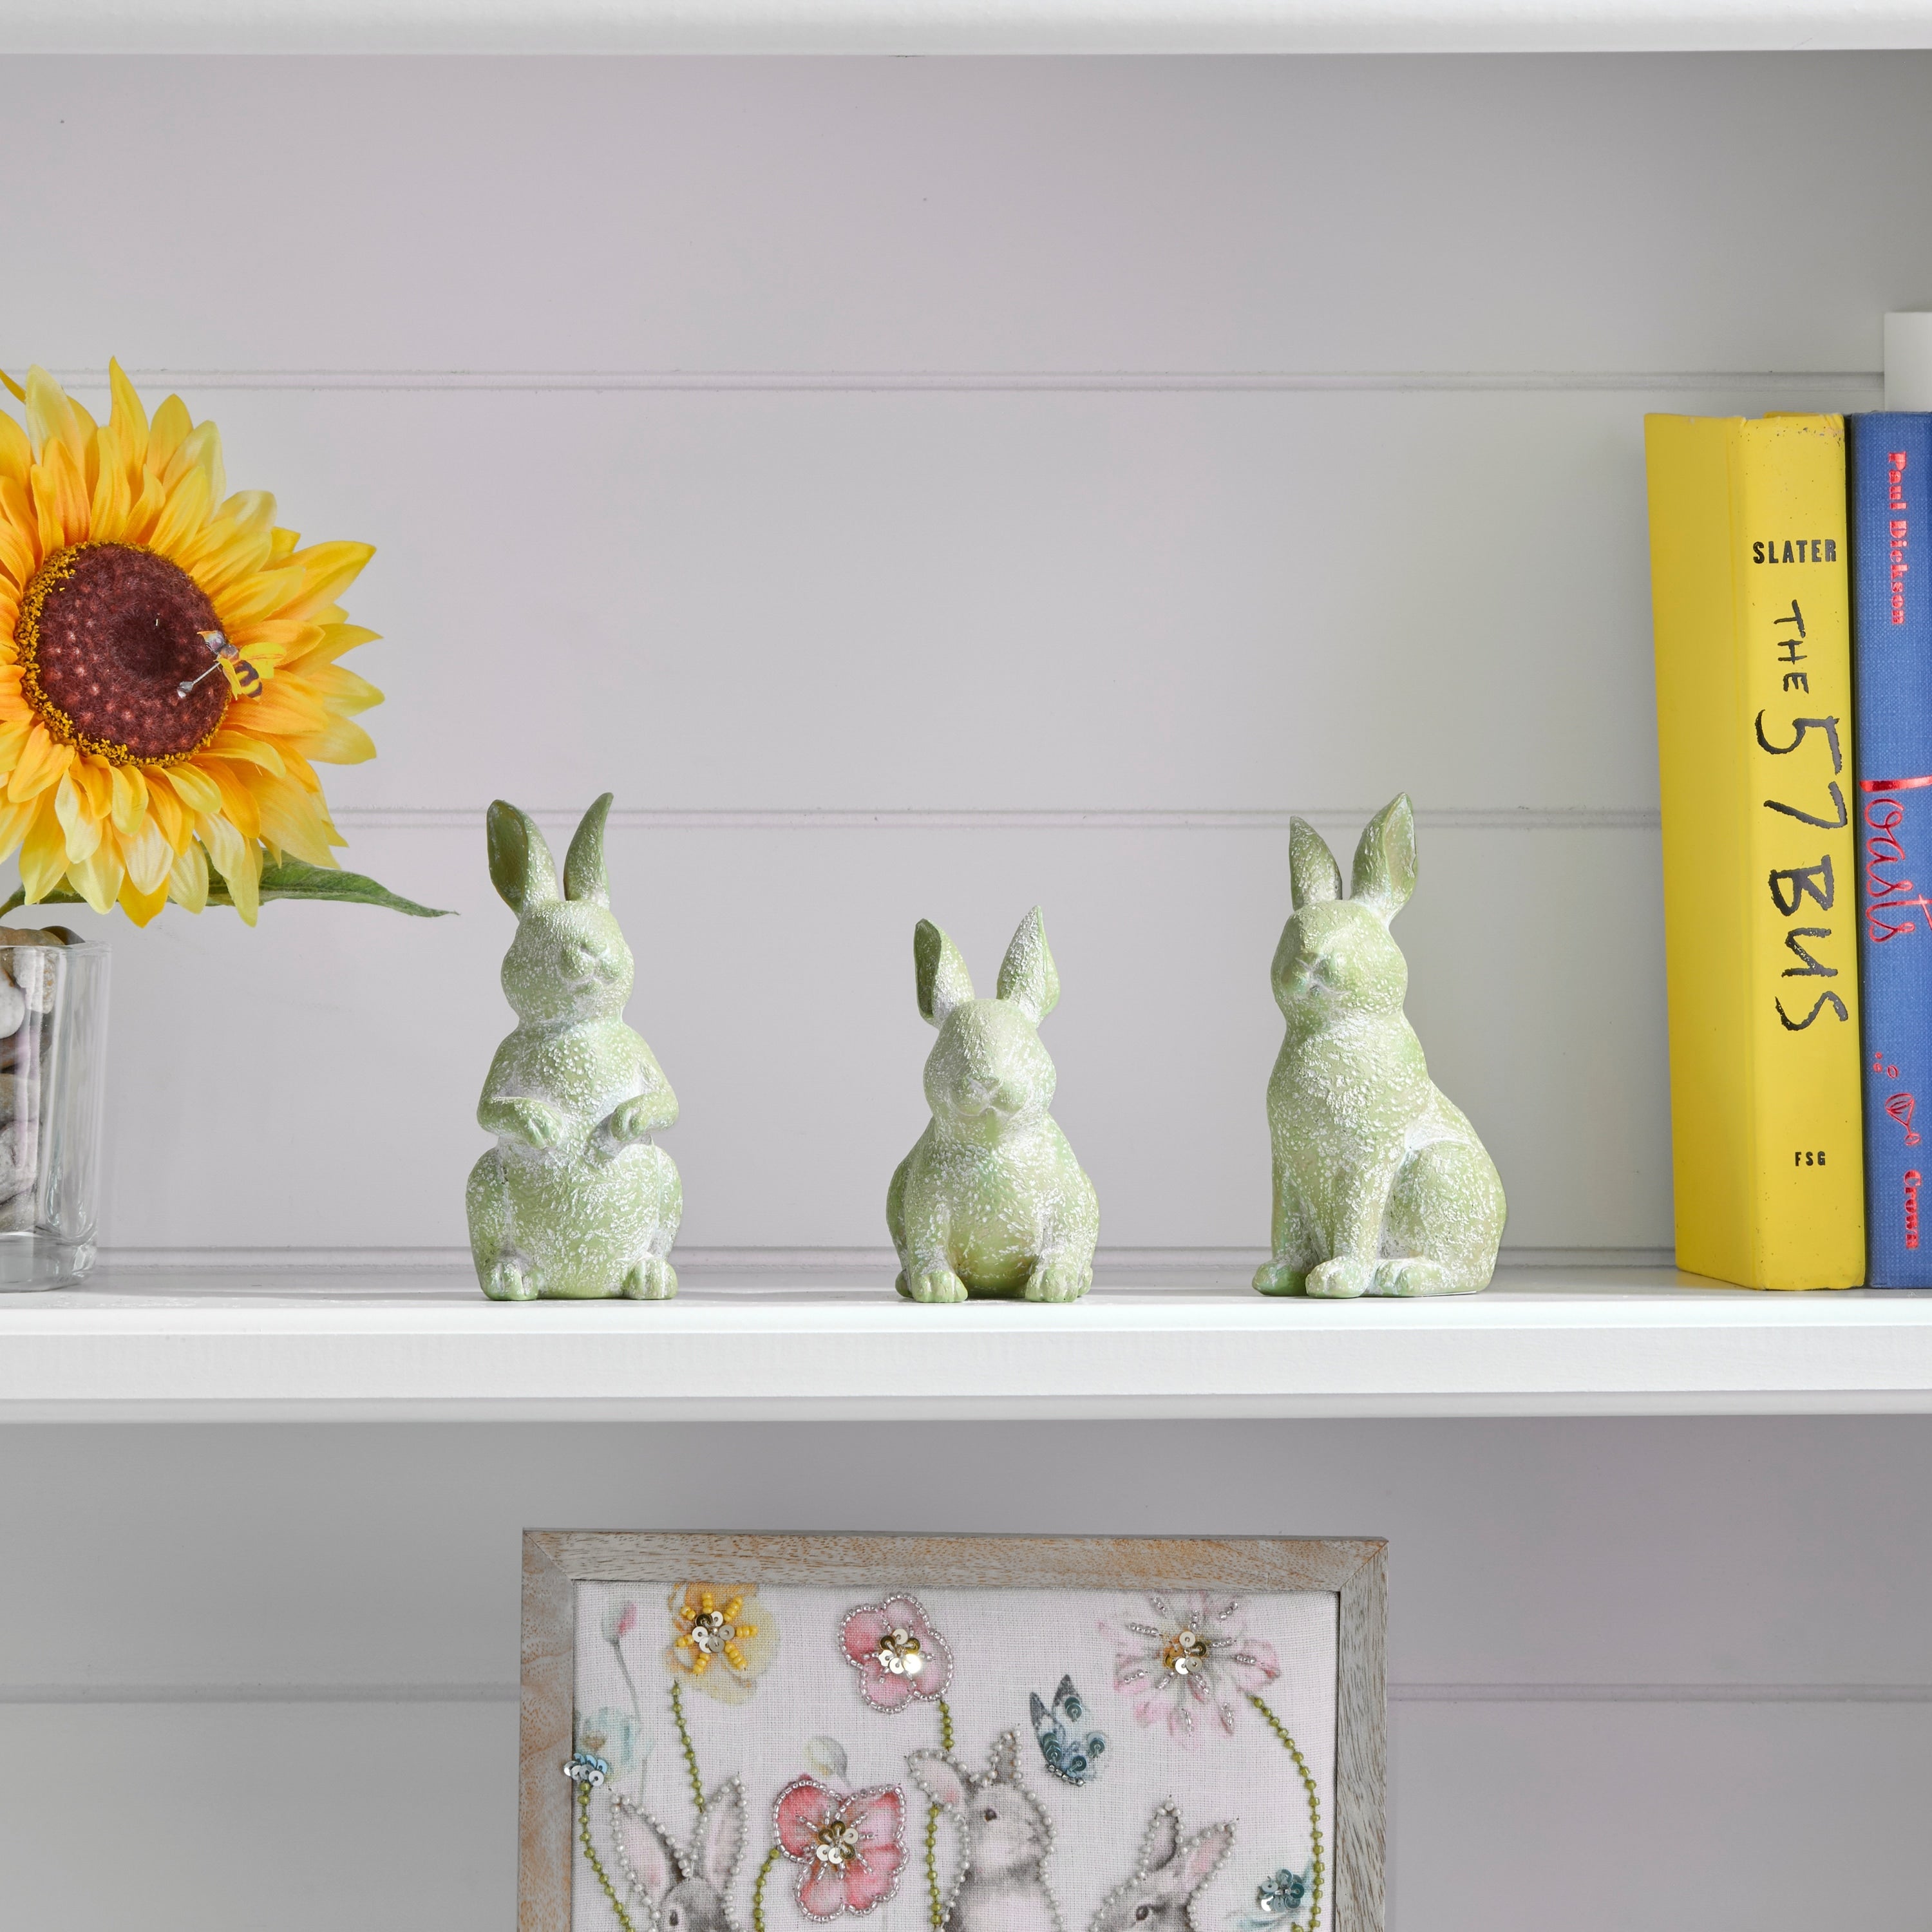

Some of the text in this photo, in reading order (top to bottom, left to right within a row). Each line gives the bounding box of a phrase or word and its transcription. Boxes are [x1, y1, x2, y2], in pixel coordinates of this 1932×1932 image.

[1753, 539, 1836, 564] SLATER
[1888, 451, 1908, 625] Paul Dickson
[1756, 600, 1848, 1031] THE 57 BUS
[1795, 1151, 1826, 1166] FSG
[1904, 1170, 1922, 1249] Crown
